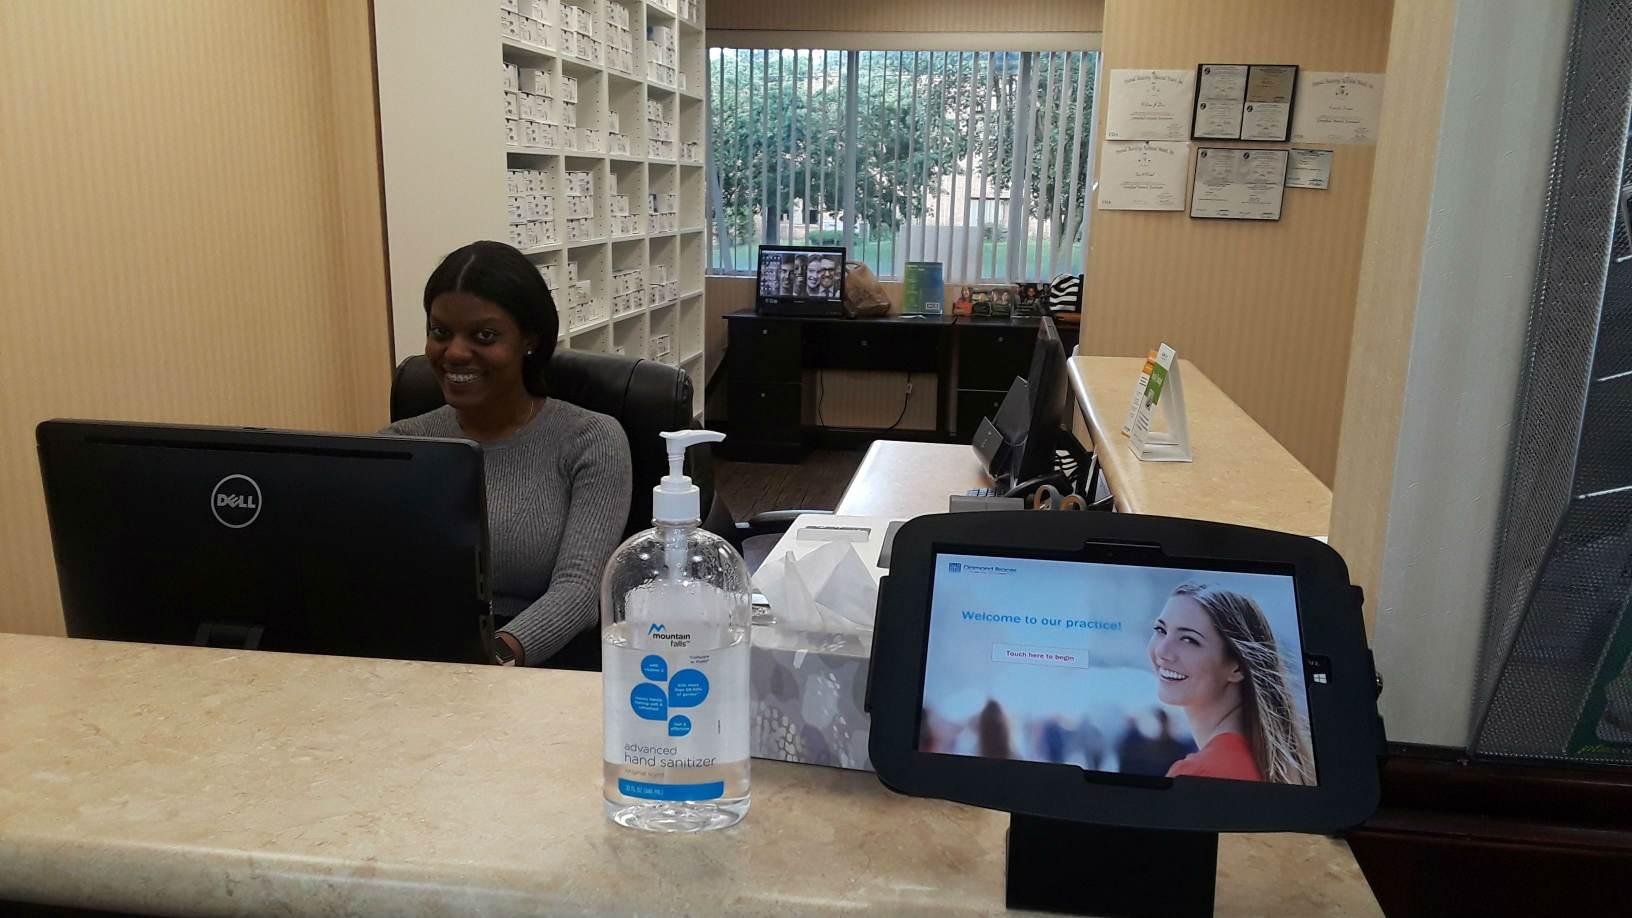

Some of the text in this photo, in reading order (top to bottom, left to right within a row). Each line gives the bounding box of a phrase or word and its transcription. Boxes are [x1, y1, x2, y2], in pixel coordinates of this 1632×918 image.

[216, 493, 257, 509] DELL
[961, 610, 1123, 631] Welcome to our practice!
[1006, 650, 1027, 658] Touch
[1028, 651, 1044, 659] here
[1055, 654, 1075, 662] begin
[623, 743, 678, 756] advanced
[624, 751, 717, 769] hand sanitizer
